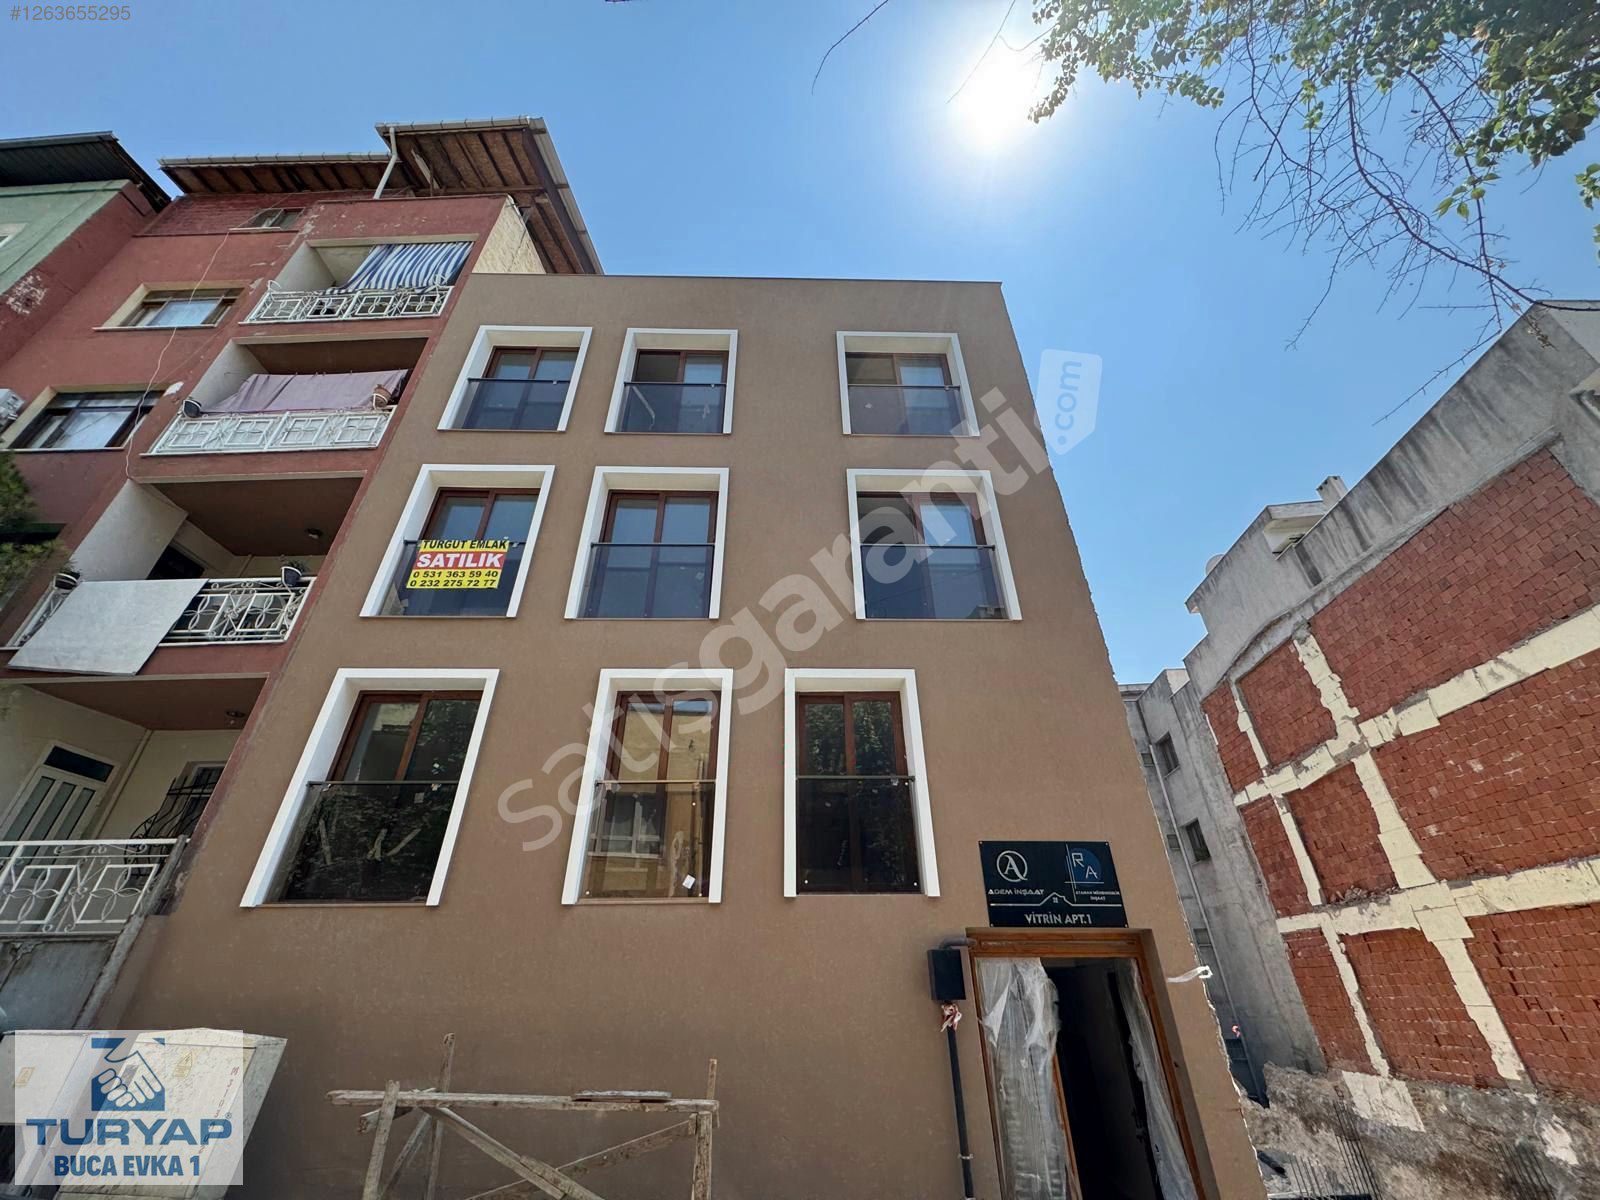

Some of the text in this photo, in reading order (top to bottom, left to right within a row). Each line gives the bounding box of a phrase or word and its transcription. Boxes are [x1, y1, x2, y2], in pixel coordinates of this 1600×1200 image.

[423, 540, 506, 549] TURGUT EMLAK
[417, 553, 504, 568] SATILIK
[484, 570, 499, 578] 40
[443, 579, 463, 587] 275
[1014, 887, 1045, 896] İNŞAAT
[1024, 911, 1063, 924] VİTRİN
